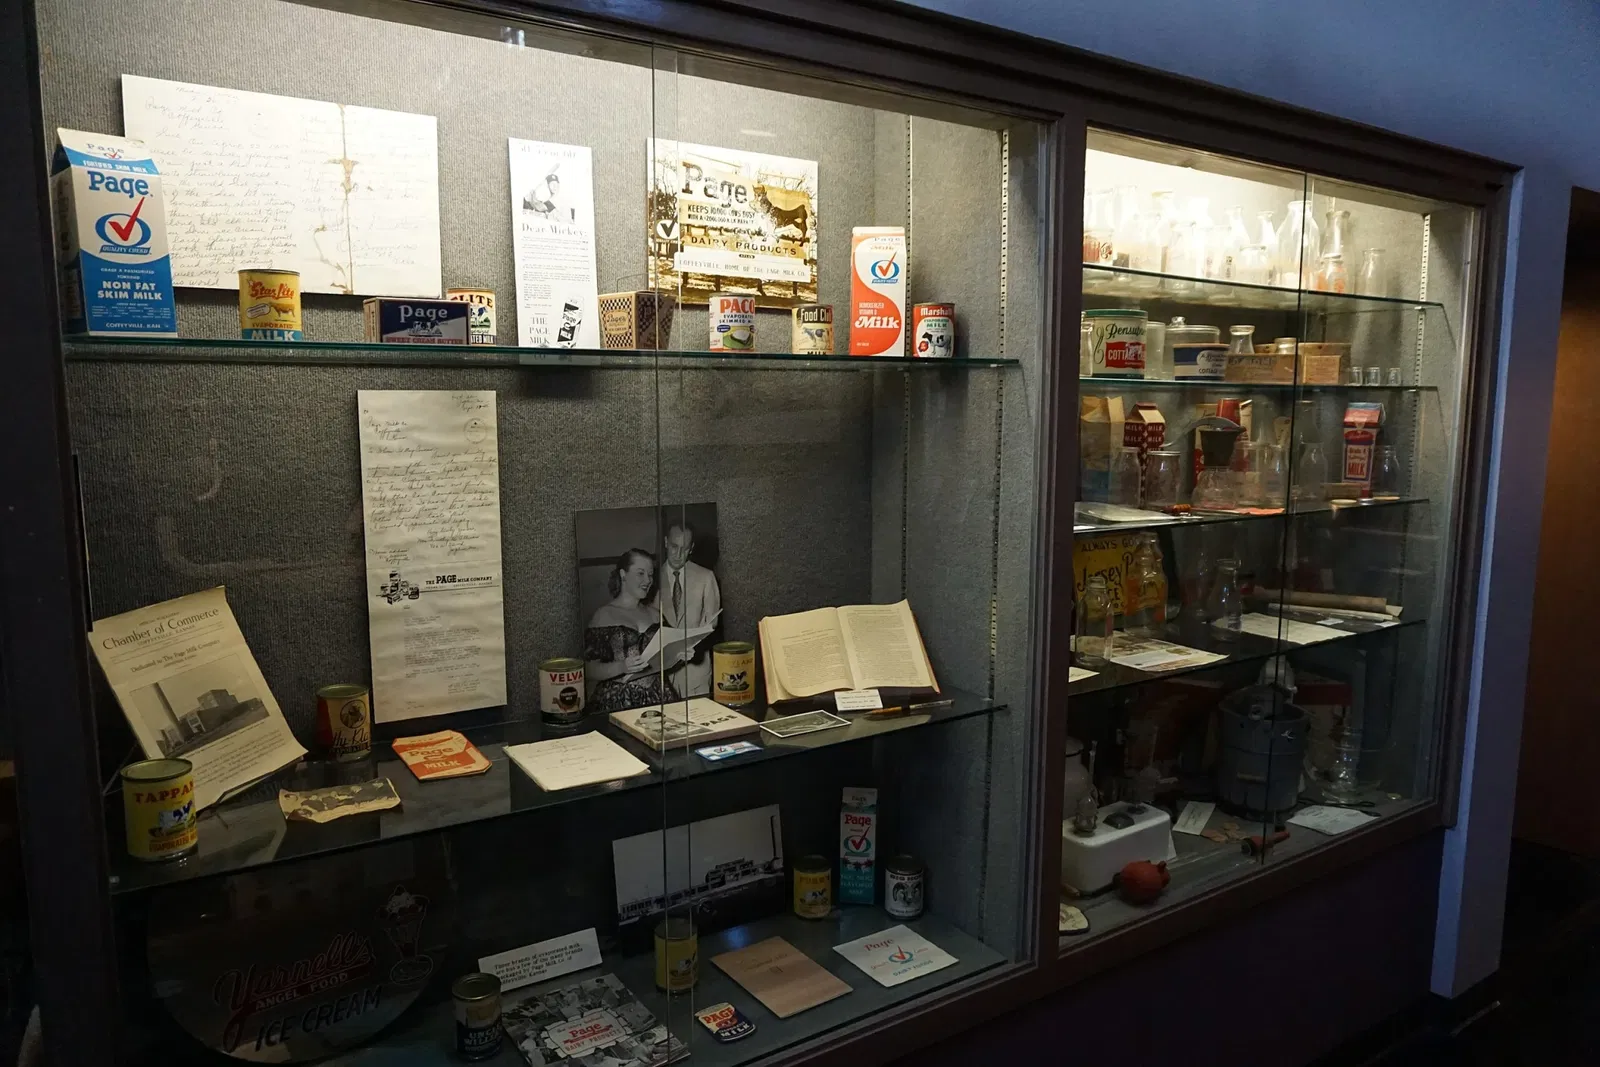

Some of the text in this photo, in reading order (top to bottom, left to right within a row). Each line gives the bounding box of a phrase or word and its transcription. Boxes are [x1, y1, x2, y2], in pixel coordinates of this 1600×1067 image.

[86, 143, 125, 154] Page
[87, 170, 149, 199] Page
[681, 161, 748, 208] Page
[687, 204, 709, 214] KEEPS
[522, 223, 545, 233] Dear
[691, 236, 728, 247] DAIRY
[735, 241, 797, 256] PRODUCTS
[724, 263, 739, 271] HOME
[102, 280, 156, 291] NON FAT
[97, 290, 162, 300] SKIM MILK
[530, 316, 548, 325] THE
[562, 313, 577, 324] Page
[800, 308, 818, 322] Food
[252, 321, 294, 329] EVAPORATED
[854, 315, 900, 329] Milk
[251, 330, 295, 341] MILK
[529, 326, 551, 335] PAGE
[530, 336, 550, 344] MILK
[1125, 424, 1143, 432] MILK
[1347, 462, 1366, 476] MILK
[1081, 539, 1118, 552] ALWAYS
[436, 574, 457, 585] PAGE
[102, 628, 152, 650] Chamber
[155, 623, 165, 634] of
[167, 607, 220, 630] Commerce
[130, 659, 157, 673] Dedicated
[163, 655, 174, 663] The
[174, 650, 186, 660] Page
[186, 645, 197, 654] Milk
[198, 639, 220, 650] Company
[700, 714, 738, 727] PAGE
[408, 747, 454, 759] Page
[424, 760, 461, 769] MILK
[844, 813, 872, 827] Page
[864, 938, 894, 952] Page
[512, 956, 530, 966] brands
[538, 946, 567, 958] evaporated
[254, 972, 349, 1011] ANGEL FOOD
[254, 985, 382, 1052] ICE CREAM
[702, 1006, 737, 1024] PAGE
[569, 1023, 602, 1038] Page
[720, 1023, 751, 1037] MILK
[565, 1040, 585, 1052] DAIRY
